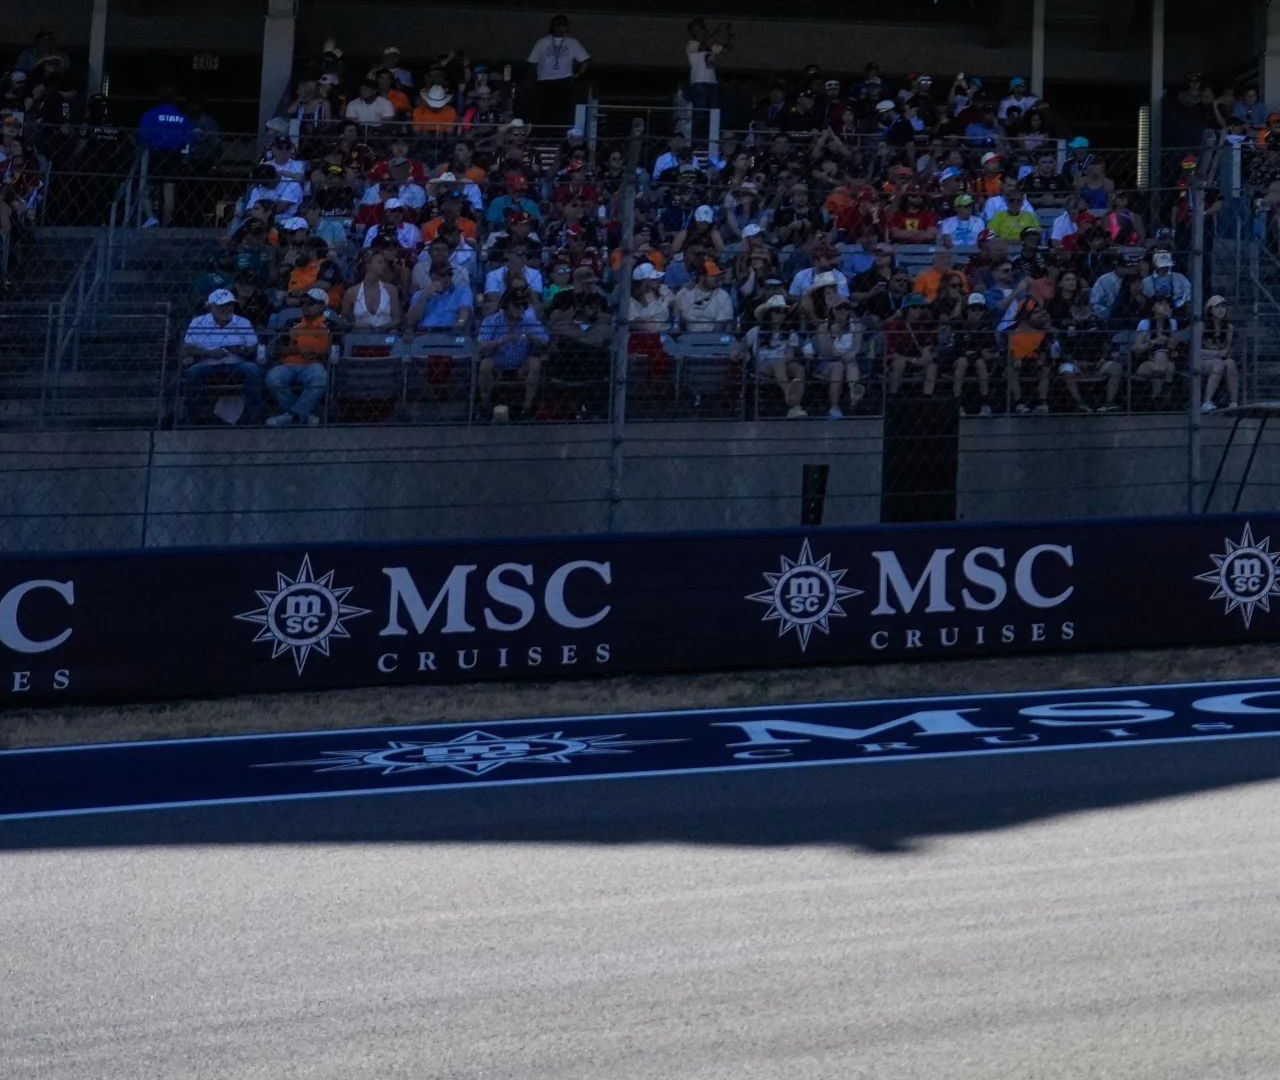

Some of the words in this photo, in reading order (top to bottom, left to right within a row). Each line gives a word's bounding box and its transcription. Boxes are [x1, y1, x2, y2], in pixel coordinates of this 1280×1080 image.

[380, 560, 611, 635] MSC
[872, 544, 1073, 615] MSC
[378, 644, 610, 672] CRUISES
[871, 622, 1074, 649] CRUISES
